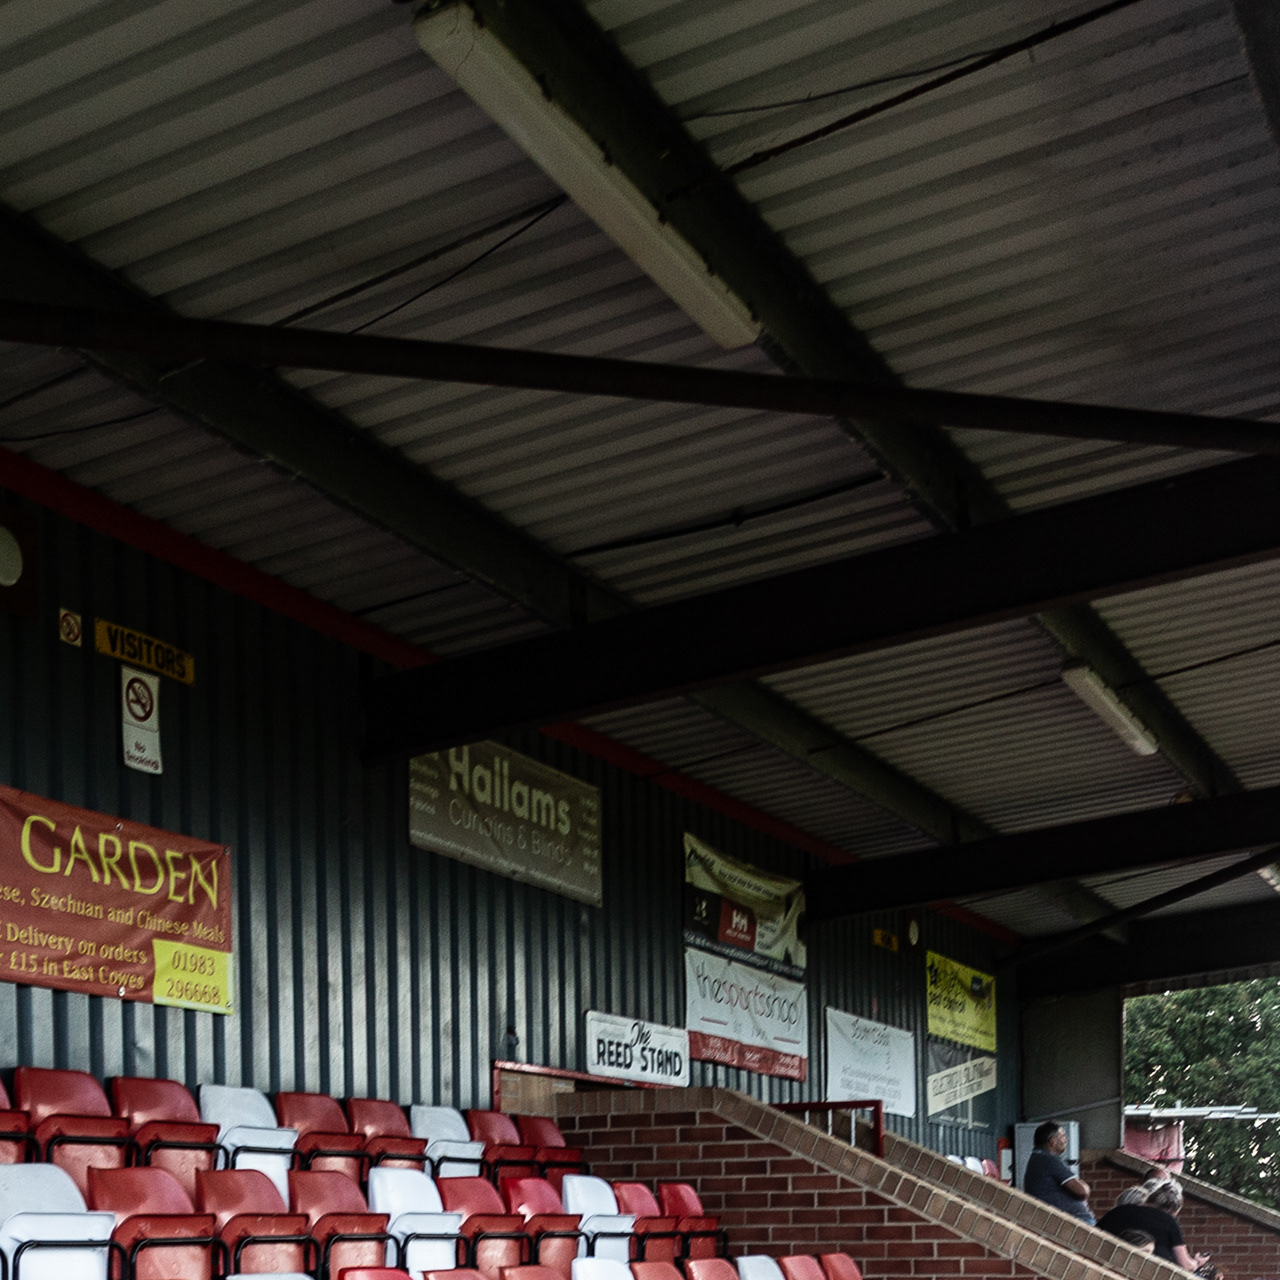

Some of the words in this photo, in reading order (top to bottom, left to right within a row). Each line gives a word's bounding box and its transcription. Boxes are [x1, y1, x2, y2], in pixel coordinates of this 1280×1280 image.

[107, 626, 186, 679] VISITORS
[449, 745, 571, 835] Hallams
[449, 798, 514, 846] Curtains
[21, 815, 219, 911] GARDEN
[30, 887, 104, 919] Szechuan
[107, 897, 134, 926] and
[137, 909, 190, 937] Chinese
[192, 920, 226, 944] Meals
[6, 922, 75, 955] Delivery
[78, 939, 97, 956] on
[99, 941, 148, 964] orders
[172, 950, 216, 976] 01983
[8, 950, 38, 973] £15
[42, 956, 59, 976] in
[62, 959, 94, 982] East
[98, 965, 145, 989] Cowes
[597, 1038, 633, 1070] REED
[640, 1046, 683, 1077] STAND
[631, 1022, 652, 1048] The
